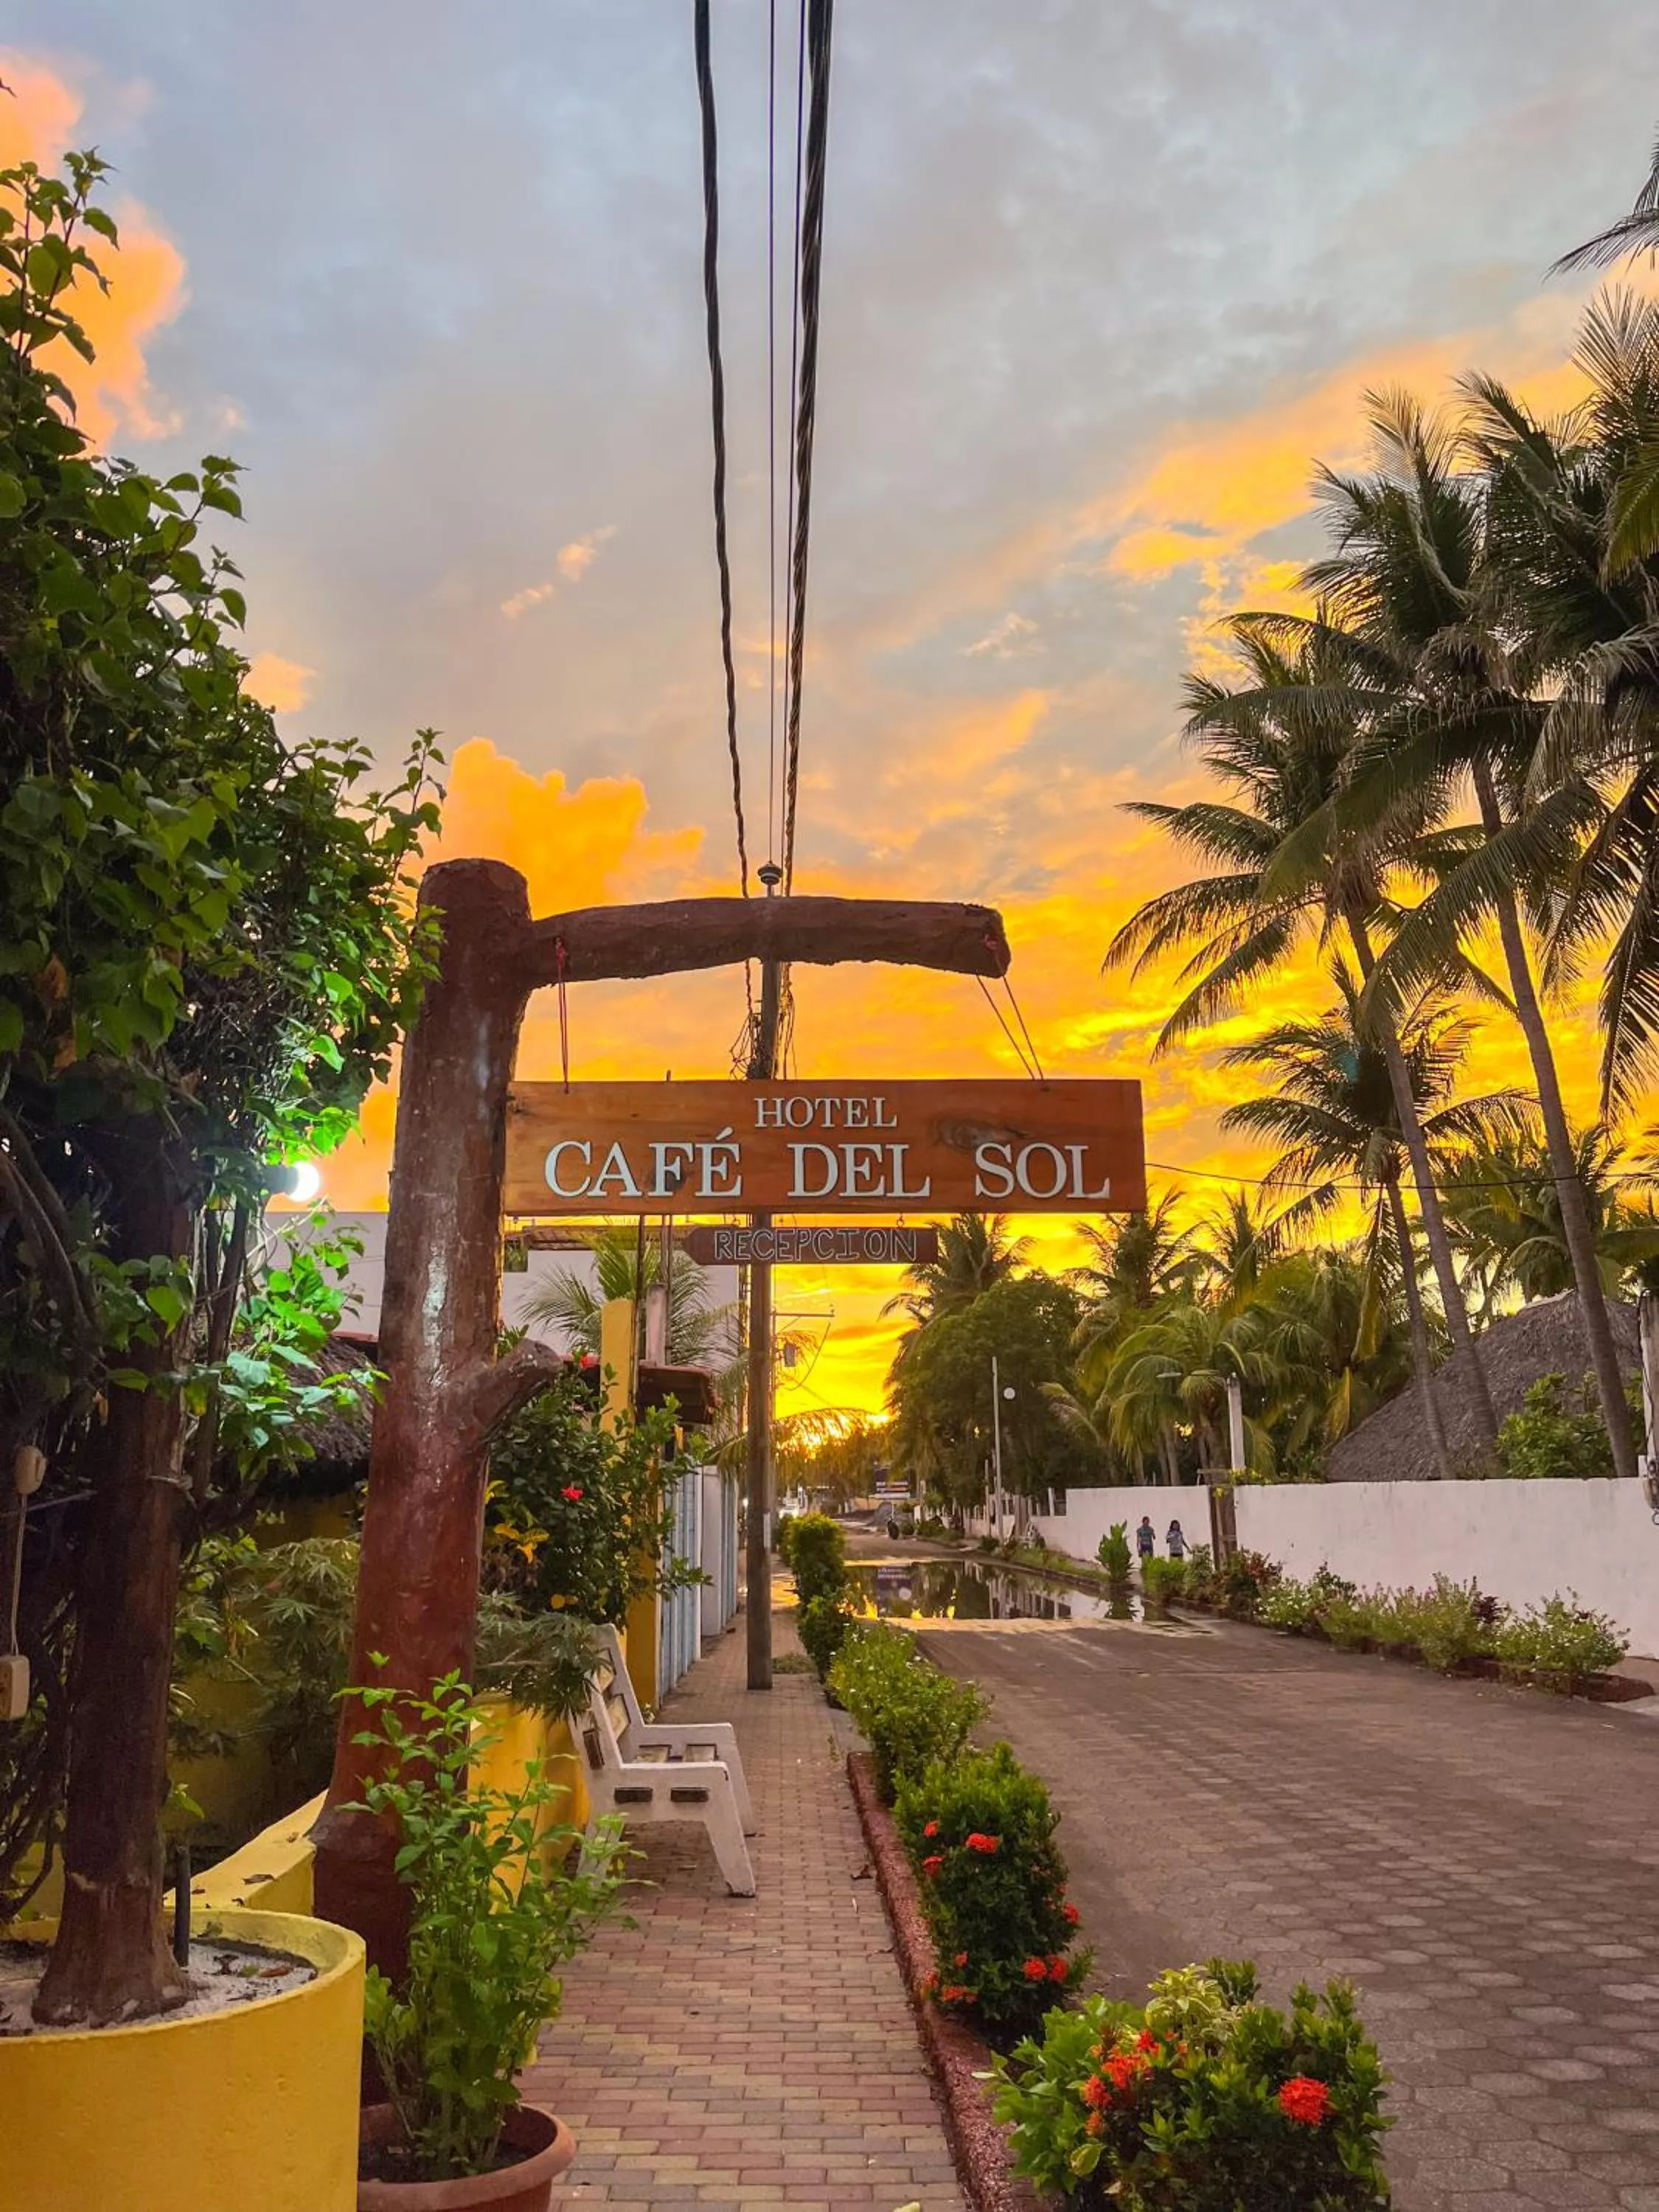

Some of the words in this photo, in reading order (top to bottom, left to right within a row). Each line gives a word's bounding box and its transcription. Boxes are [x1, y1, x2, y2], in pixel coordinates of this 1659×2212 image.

[754, 1096, 898, 1128] HOTEL
[544, 1126, 742, 1197] CAFÉ
[787, 1144, 931, 1197] DEL
[974, 1142, 1110, 1199] SOL
[713, 1227, 918, 1262] RECEPCION
